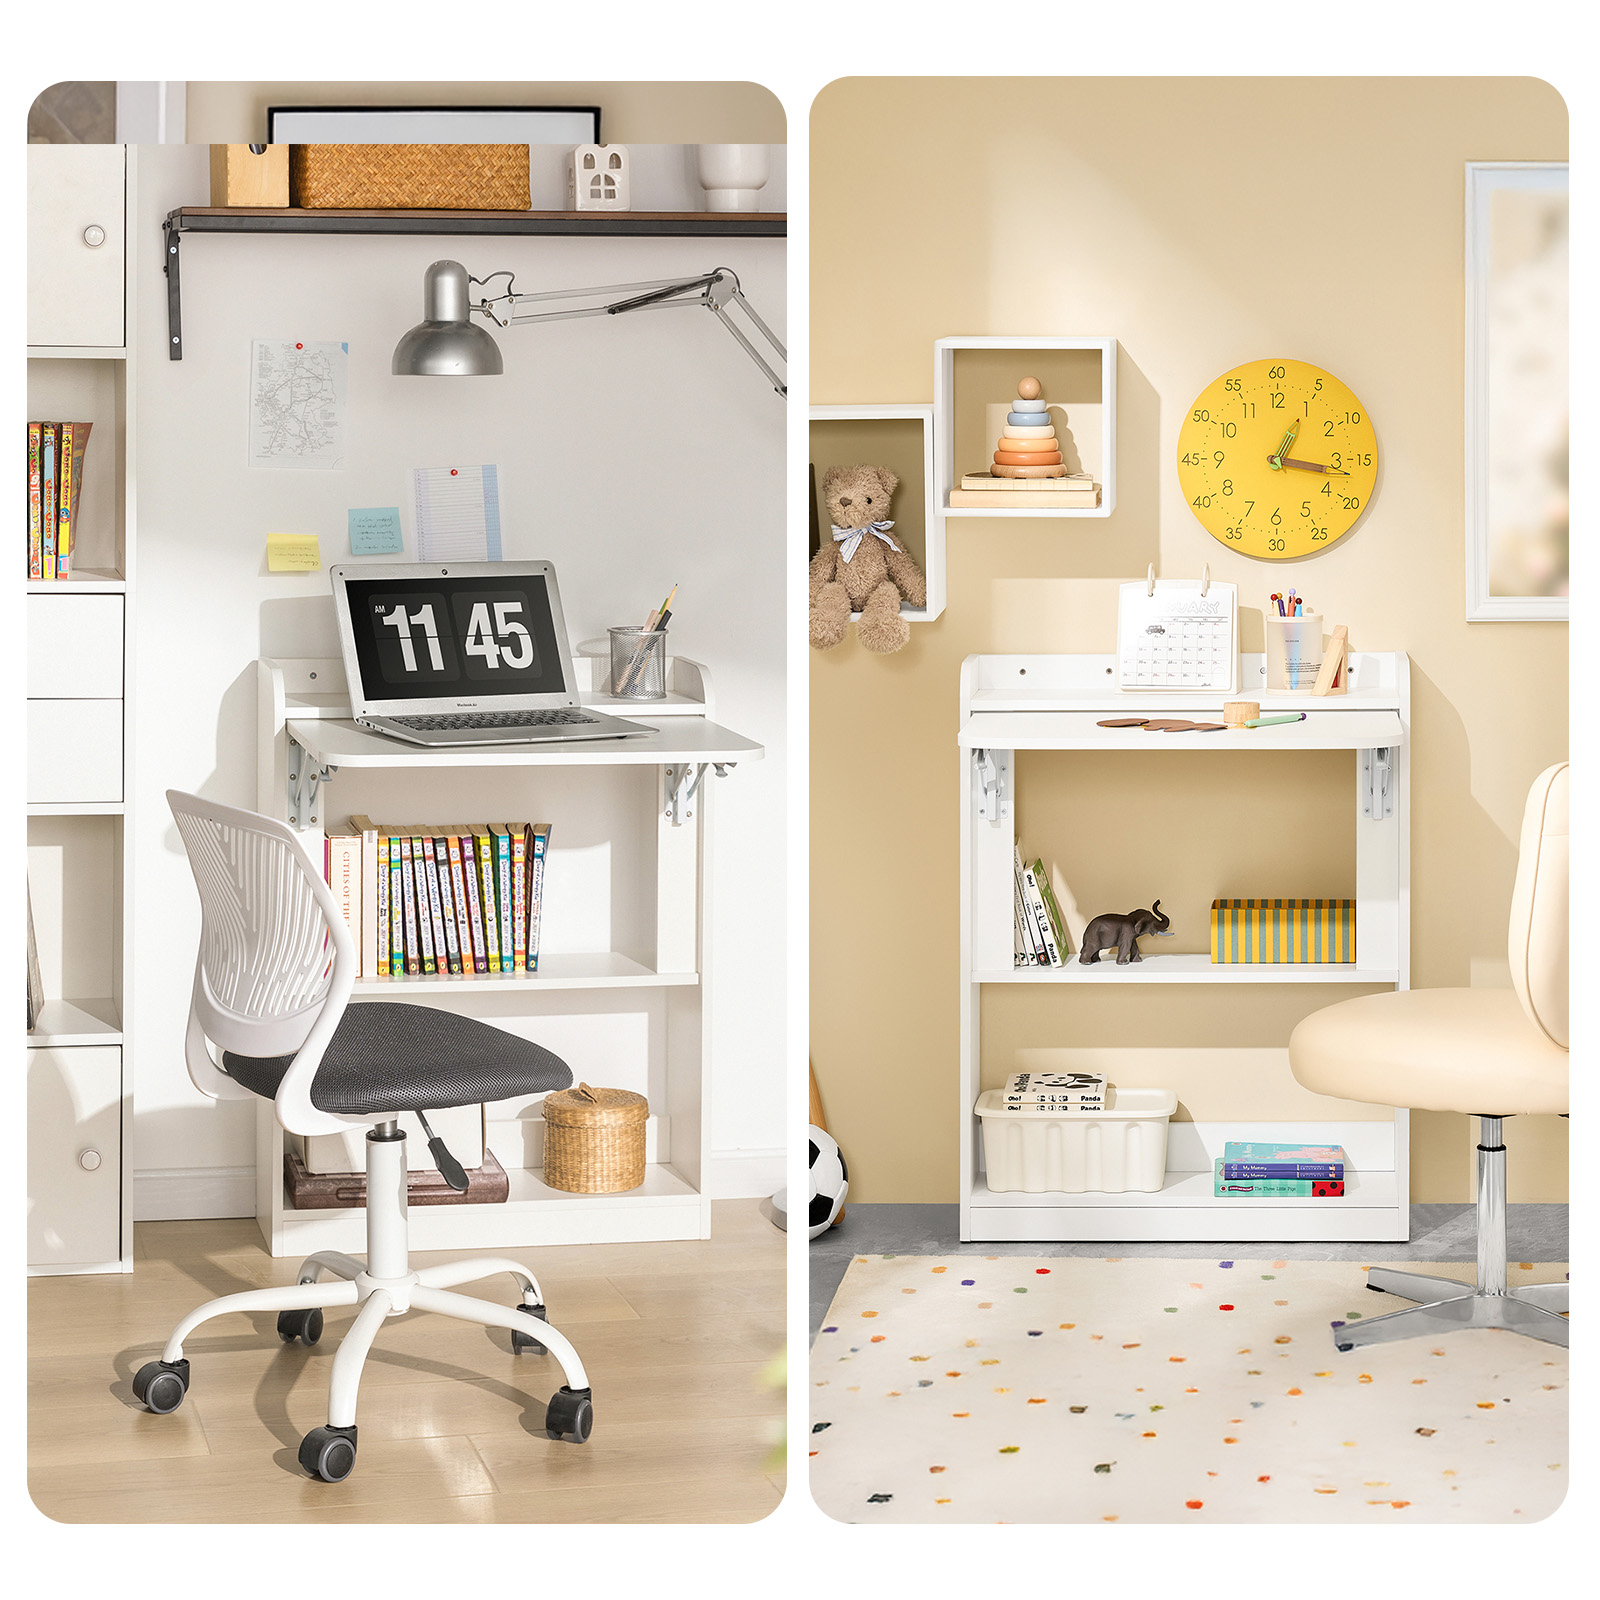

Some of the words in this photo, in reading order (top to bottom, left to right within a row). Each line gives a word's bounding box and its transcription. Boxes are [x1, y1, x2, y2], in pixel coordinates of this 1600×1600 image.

[1269, 366, 1285, 379] 60
[1224, 378, 1242, 391] 55
[1314, 378, 1323, 391] 5
[1270, 392, 1285, 409] 12
[1193, 410, 1210, 422] 50
[1242, 403, 1255, 419] 11
[1303, 401, 1308, 417] 1
[1345, 412, 1360, 425] 10
[1221, 422, 1236, 438] 10
[1324, 421, 1334, 437] 2
[1181, 453, 1200, 466] 45
[1214, 451, 1225, 469] 9
[1330, 452, 1342, 469] 3
[1357, 454, 1371, 466] 15
[1222, 479, 1234, 496] 8
[1321, 481, 1332, 497] 4
[1193, 496, 1211, 508] 40
[1245, 501, 1255, 517] 7
[1300, 501, 1311, 517] 5
[1342, 497, 1360, 510] 20
[1270, 507, 1282, 525] 6
[1226, 528, 1242, 540] 35
[1311, 528, 1328, 540] 25
[1268, 539, 1285, 551] 30
[374, 605, 386, 613] AM
[382, 604, 444, 672] 11
[464, 601, 535, 670] 45
[343, 886, 350, 900] OF
[1048, 943, 1058, 963] Panda
